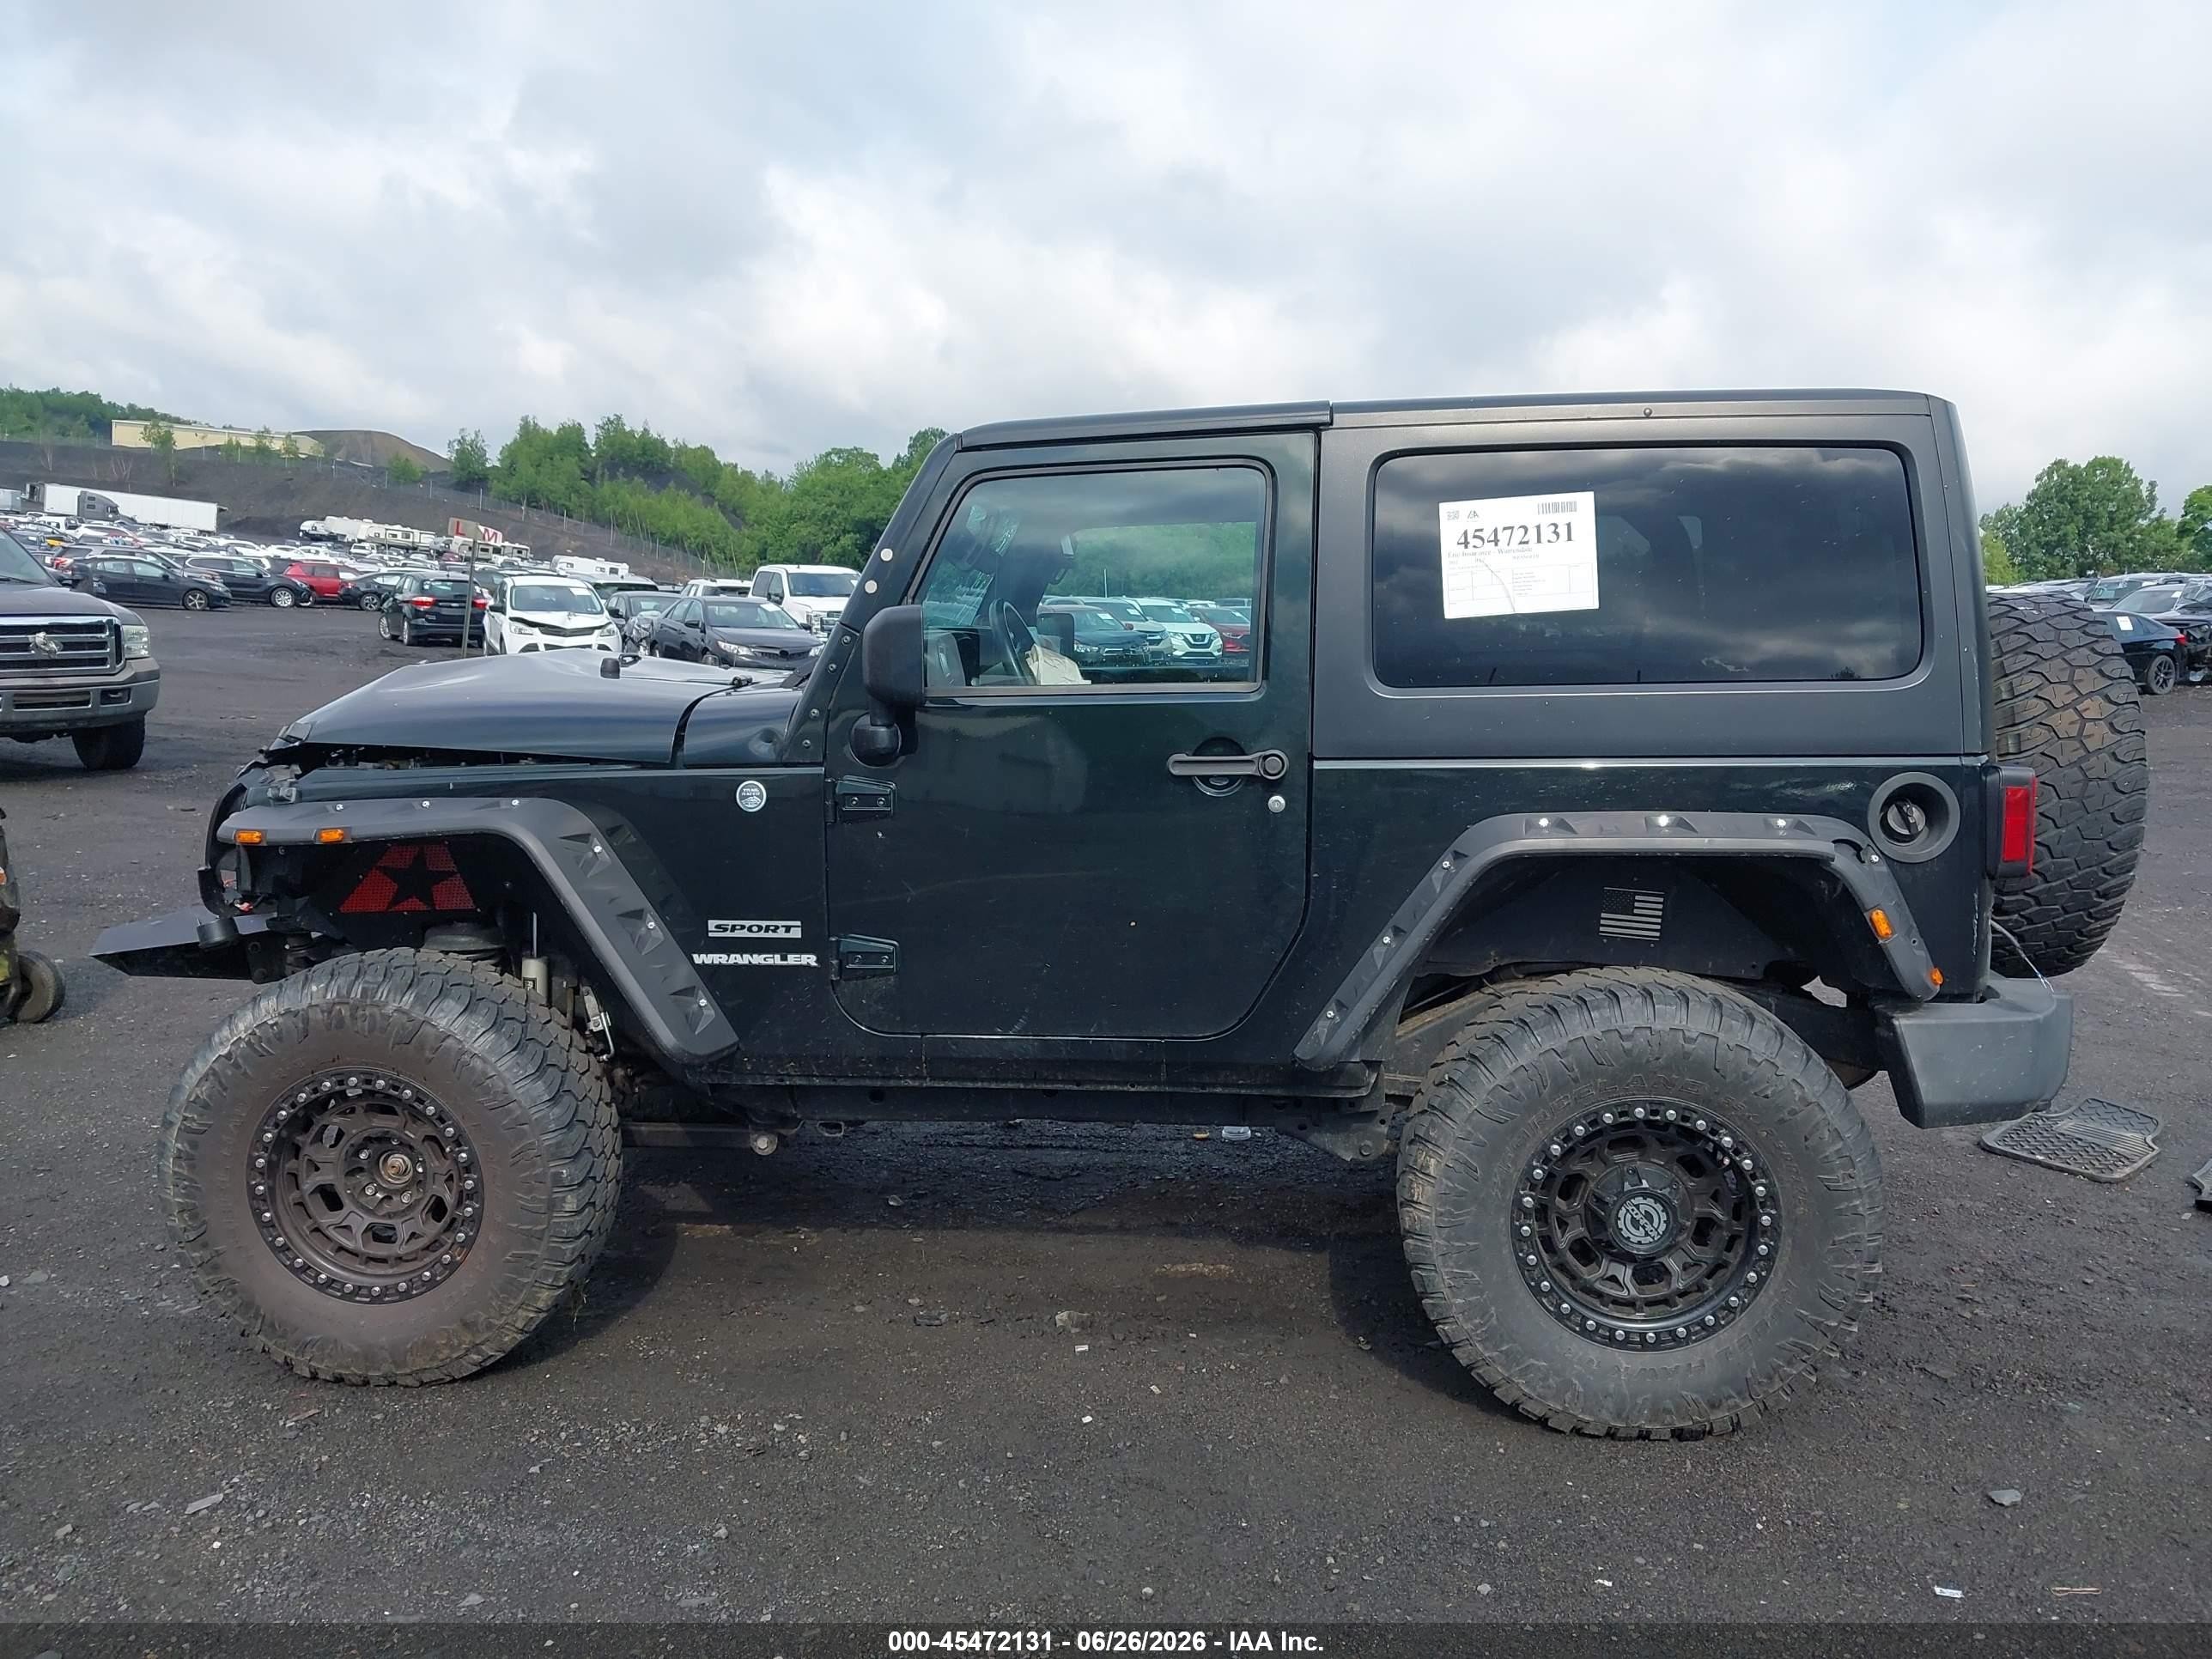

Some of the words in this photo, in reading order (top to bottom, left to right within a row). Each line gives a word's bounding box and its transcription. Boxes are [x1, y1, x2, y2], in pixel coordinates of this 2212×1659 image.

[455, 520, 465, 536] L
[483, 528, 497, 543] M
[1456, 521, 1574, 550] 45472131
[708, 922, 801, 935] SPORT
[691, 953, 819, 967] WRANGLER
[1624, 1200, 1661, 1241] SCORPION
